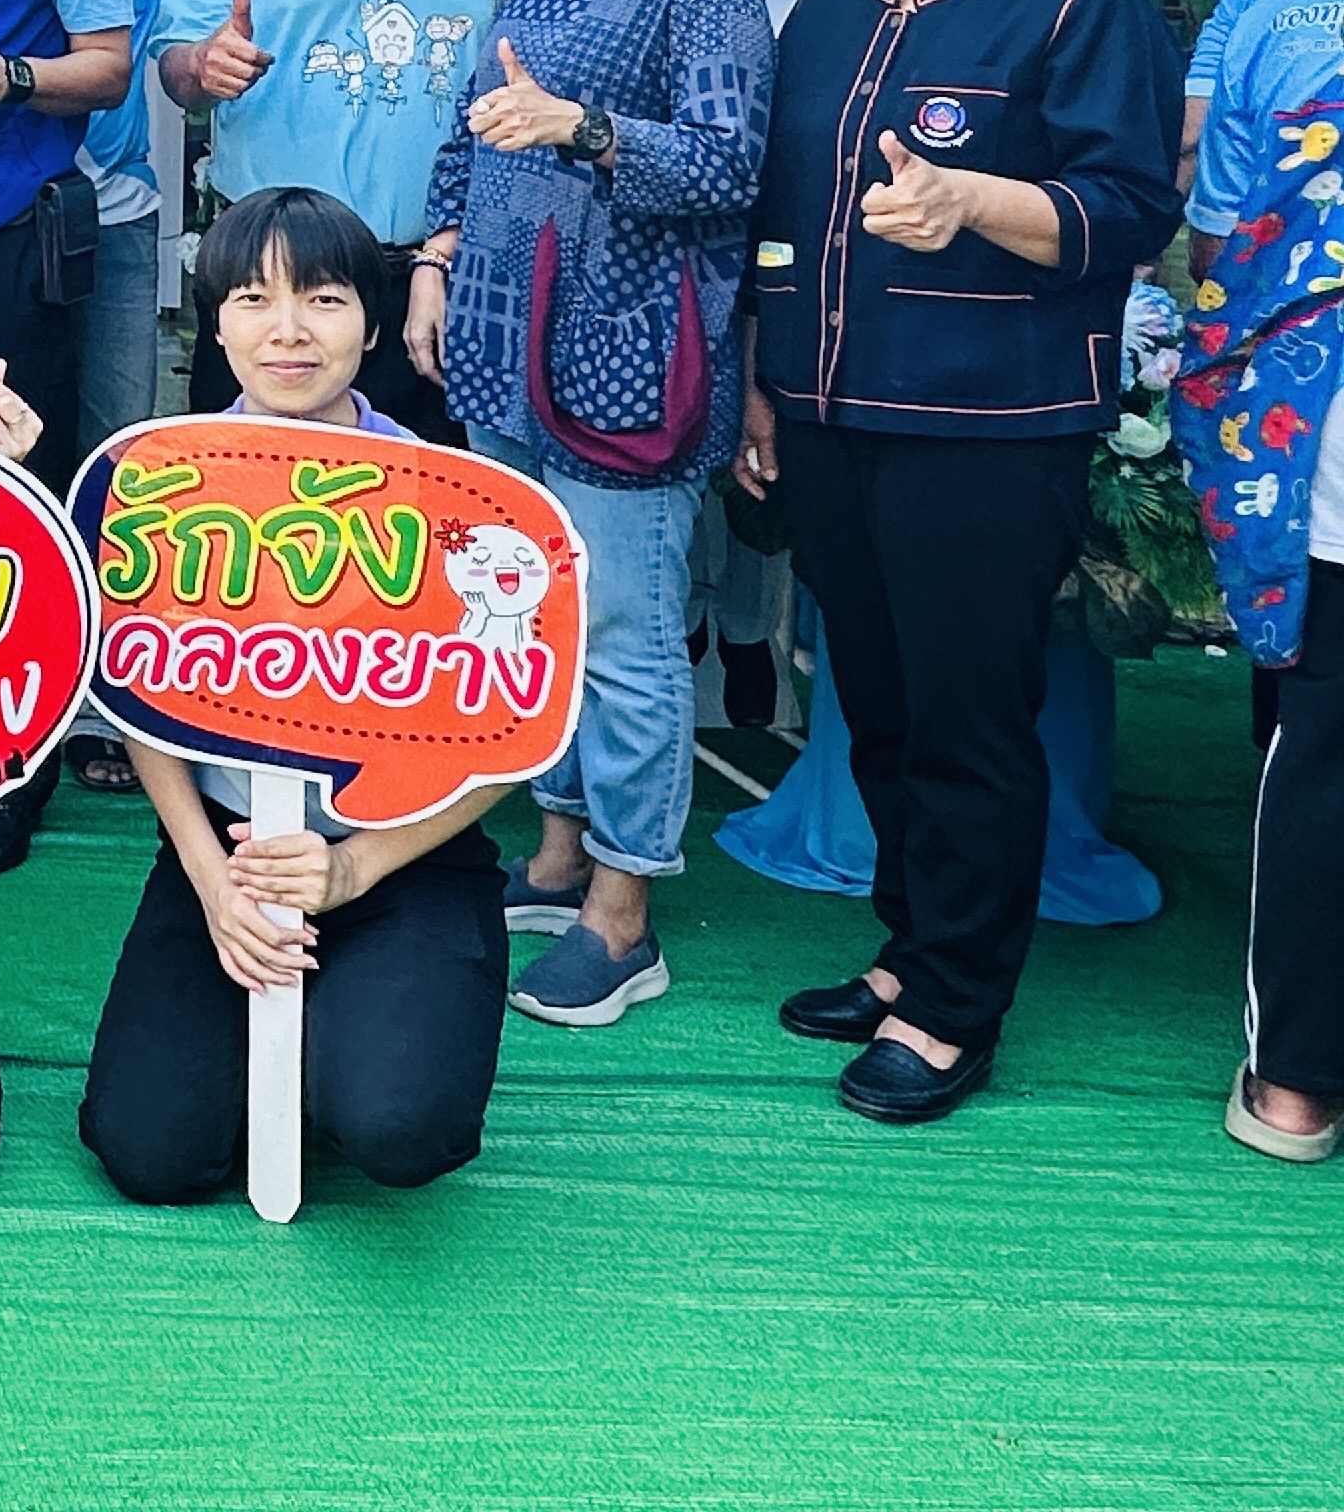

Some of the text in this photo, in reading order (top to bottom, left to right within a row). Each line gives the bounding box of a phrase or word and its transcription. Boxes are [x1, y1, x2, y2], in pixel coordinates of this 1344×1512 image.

[98, 460, 429, 609] รักจัง
[109, 620, 549, 711] คลองยาง
